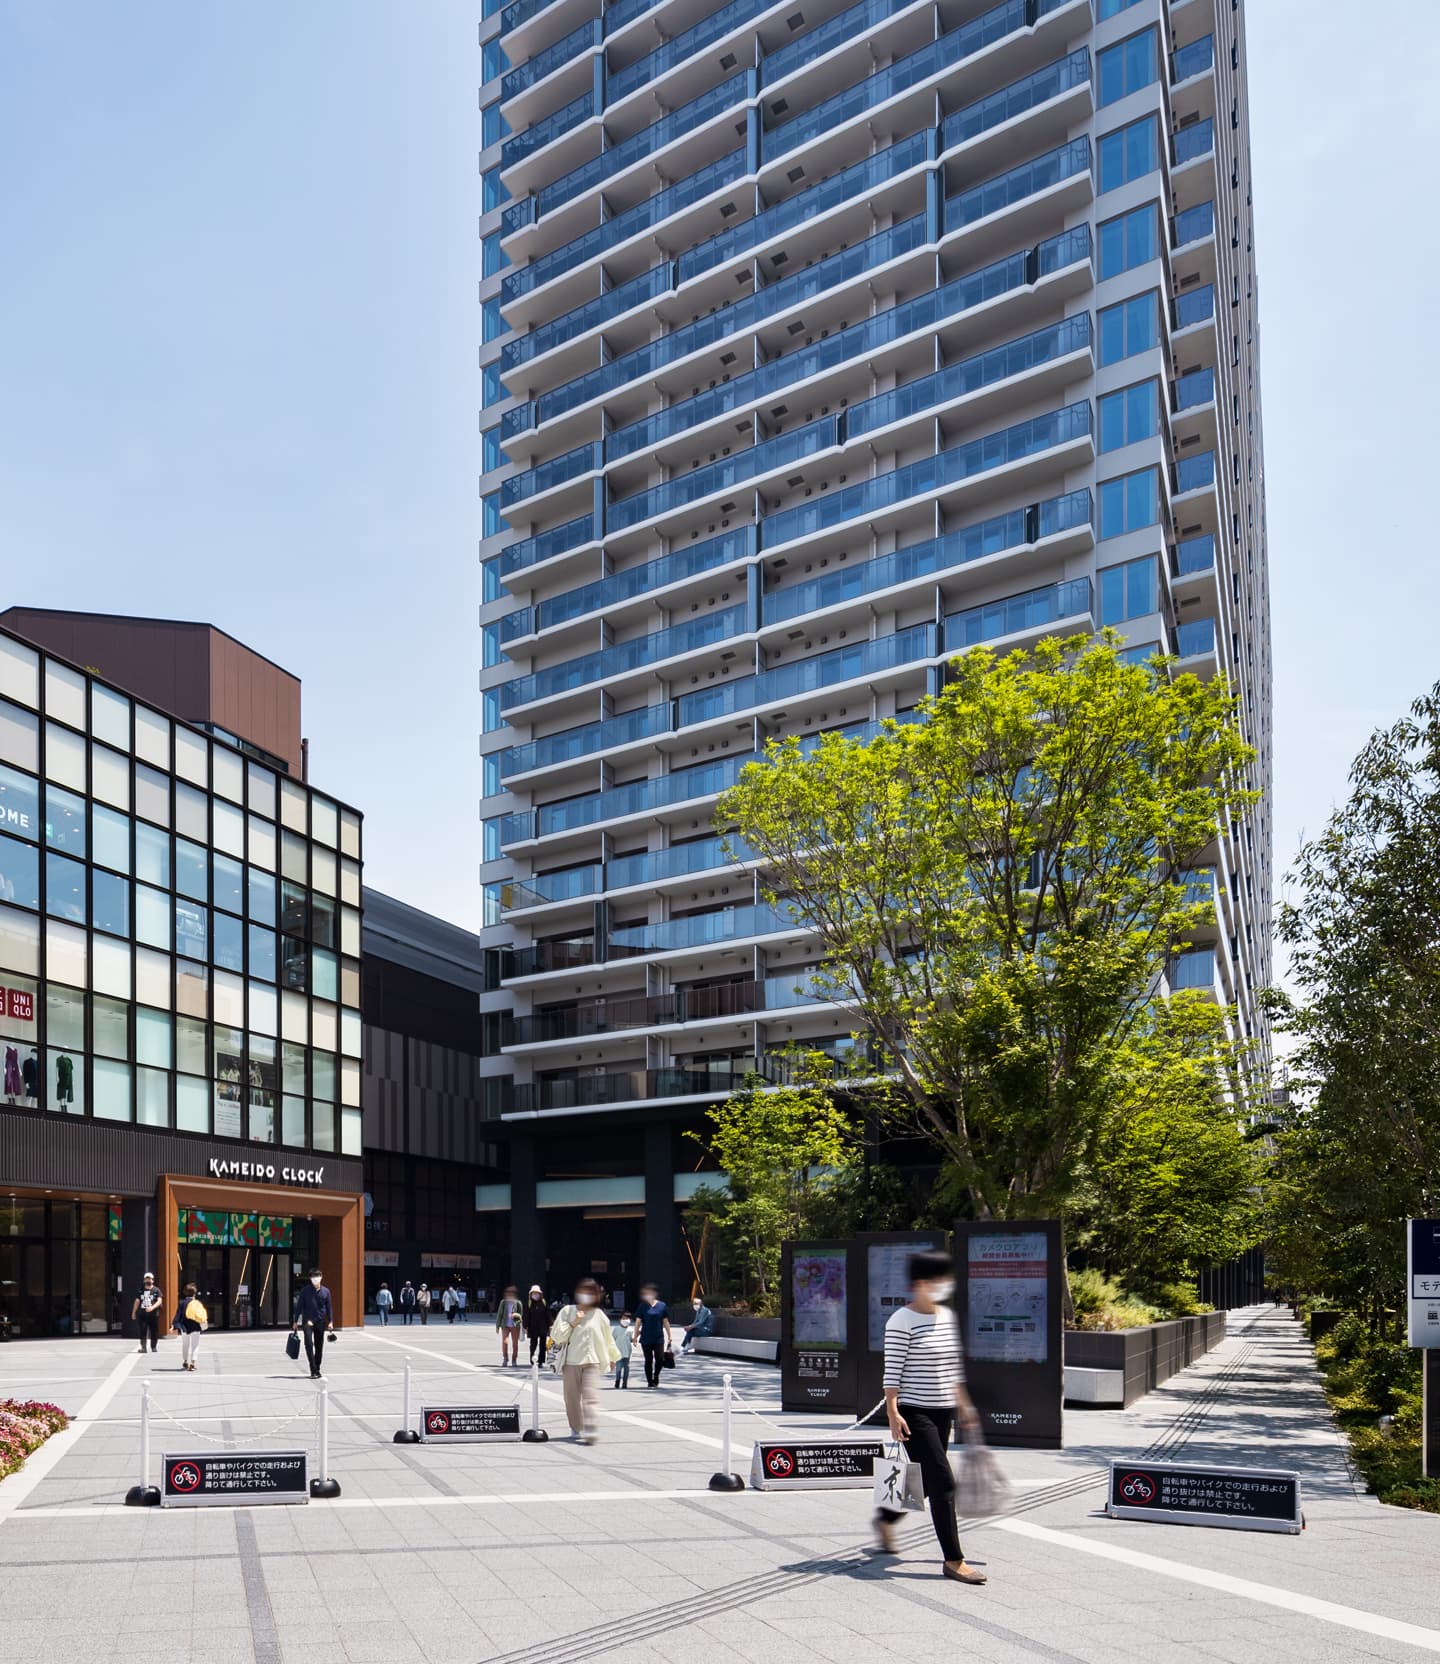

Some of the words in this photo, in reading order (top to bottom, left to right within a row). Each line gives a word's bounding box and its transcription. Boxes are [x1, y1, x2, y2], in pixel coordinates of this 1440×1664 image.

[13, 993, 30, 1006] UNI
[13, 1005, 31, 1016] QLO
[209, 1158, 275, 1178] KAMEIDO
[282, 1167, 324, 1183] CLOCK
[1162, 1477, 1288, 1494] 自転車やバイクでの走行および
[1162, 1486, 1246, 1500] 通り抜けは禁止です。
[1162, 1496, 1255, 1511] 降りて通行して下さい。
